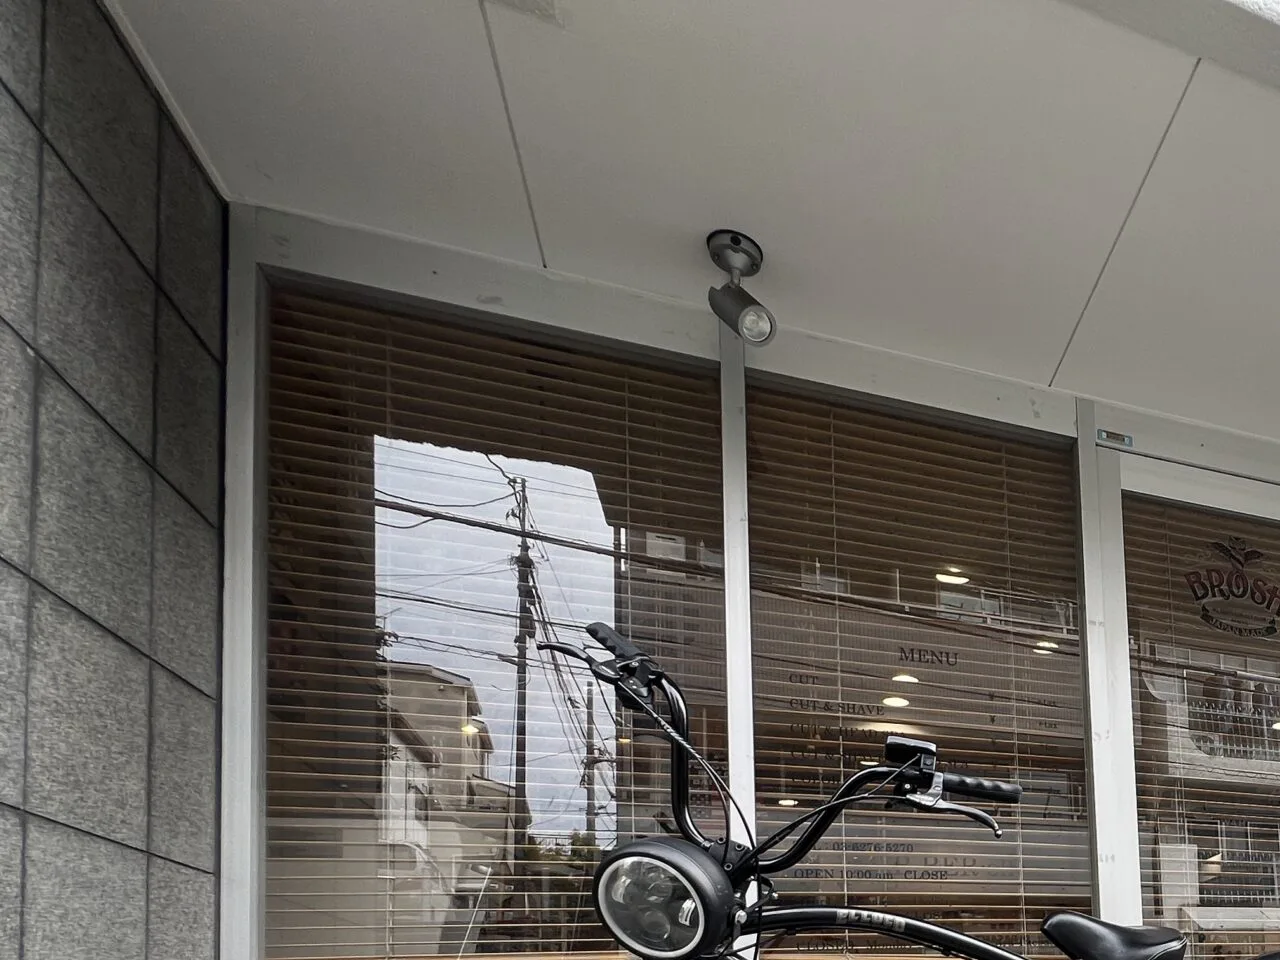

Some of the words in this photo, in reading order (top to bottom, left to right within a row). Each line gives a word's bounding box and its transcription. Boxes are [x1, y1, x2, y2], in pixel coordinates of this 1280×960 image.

[899, 648, 959, 667] MENU
[788, 674, 819, 685] CUT
[789, 698, 819, 711] CUT
[838, 702, 885, 716] SHAVE
[793, 868, 834, 880] OPEN
[903, 869, 948, 881] CLOSE
